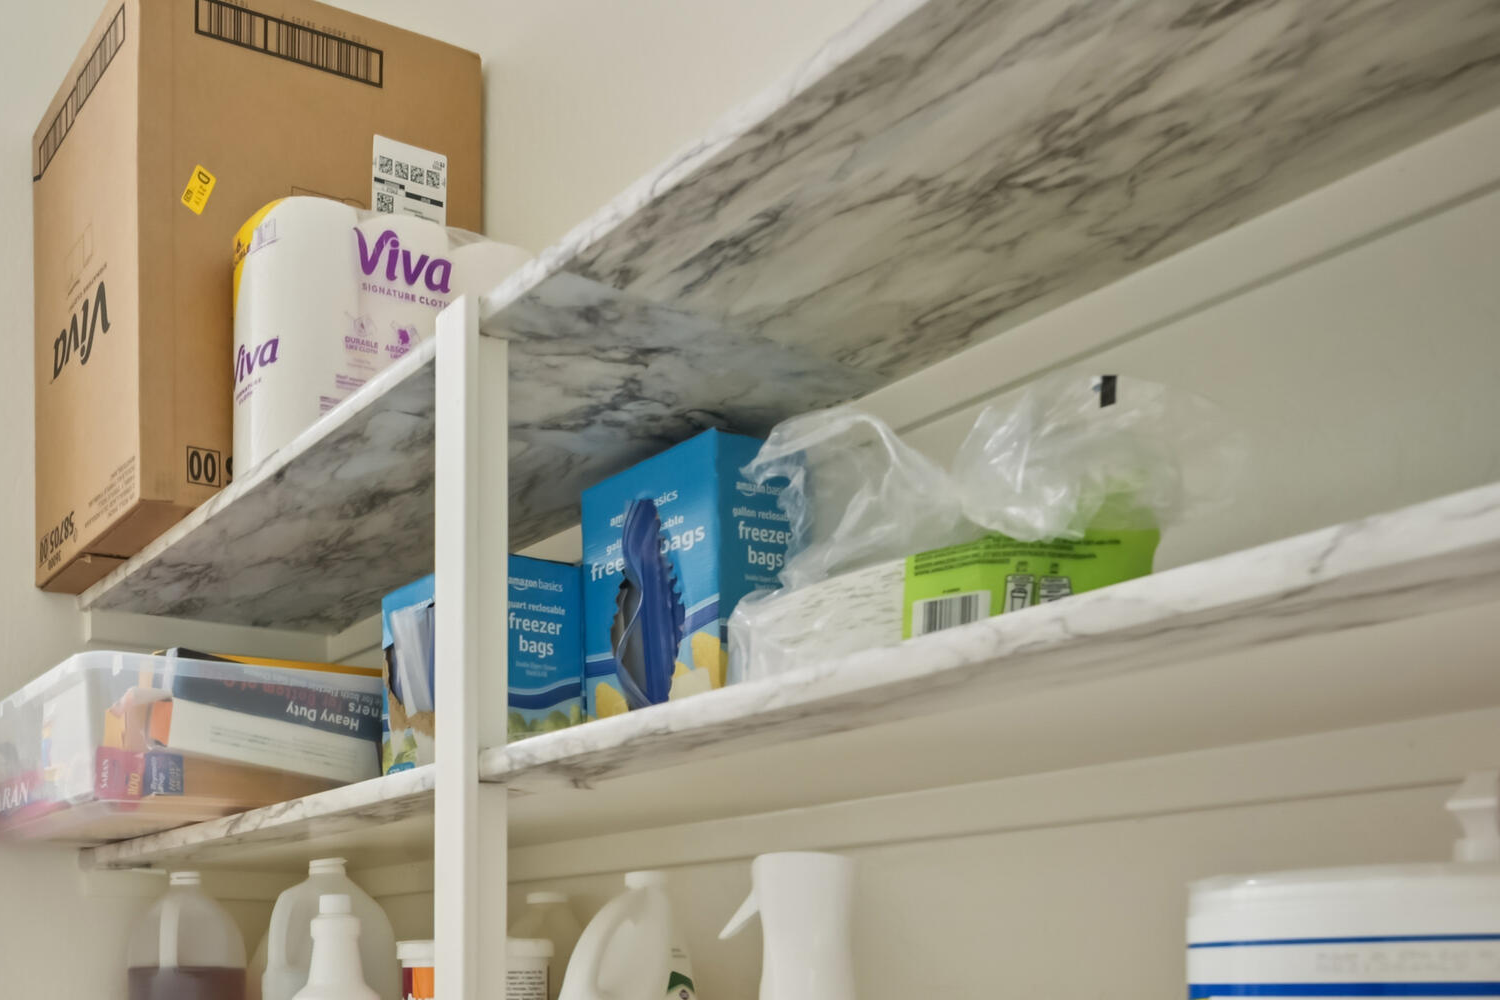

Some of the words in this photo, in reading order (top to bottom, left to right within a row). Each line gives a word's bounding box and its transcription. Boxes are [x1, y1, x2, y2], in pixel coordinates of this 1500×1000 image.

[353, 227, 452, 294] Viva
[362, 282, 416, 303] SIGNATURE
[52, 280, 111, 382] Viva
[344, 336, 379, 349] DURABLE
[738, 520, 791, 545] freezer
[748, 545, 784, 571] bags
[591, 558, 625, 582] free
[528, 603, 566, 615] reclosable
[509, 612, 562, 635] freezer
[519, 634, 554, 658] bags
[286, 701, 317, 721] Duty
[320, 710, 360, 731] Heavy
[349, 702, 381, 718] ners
